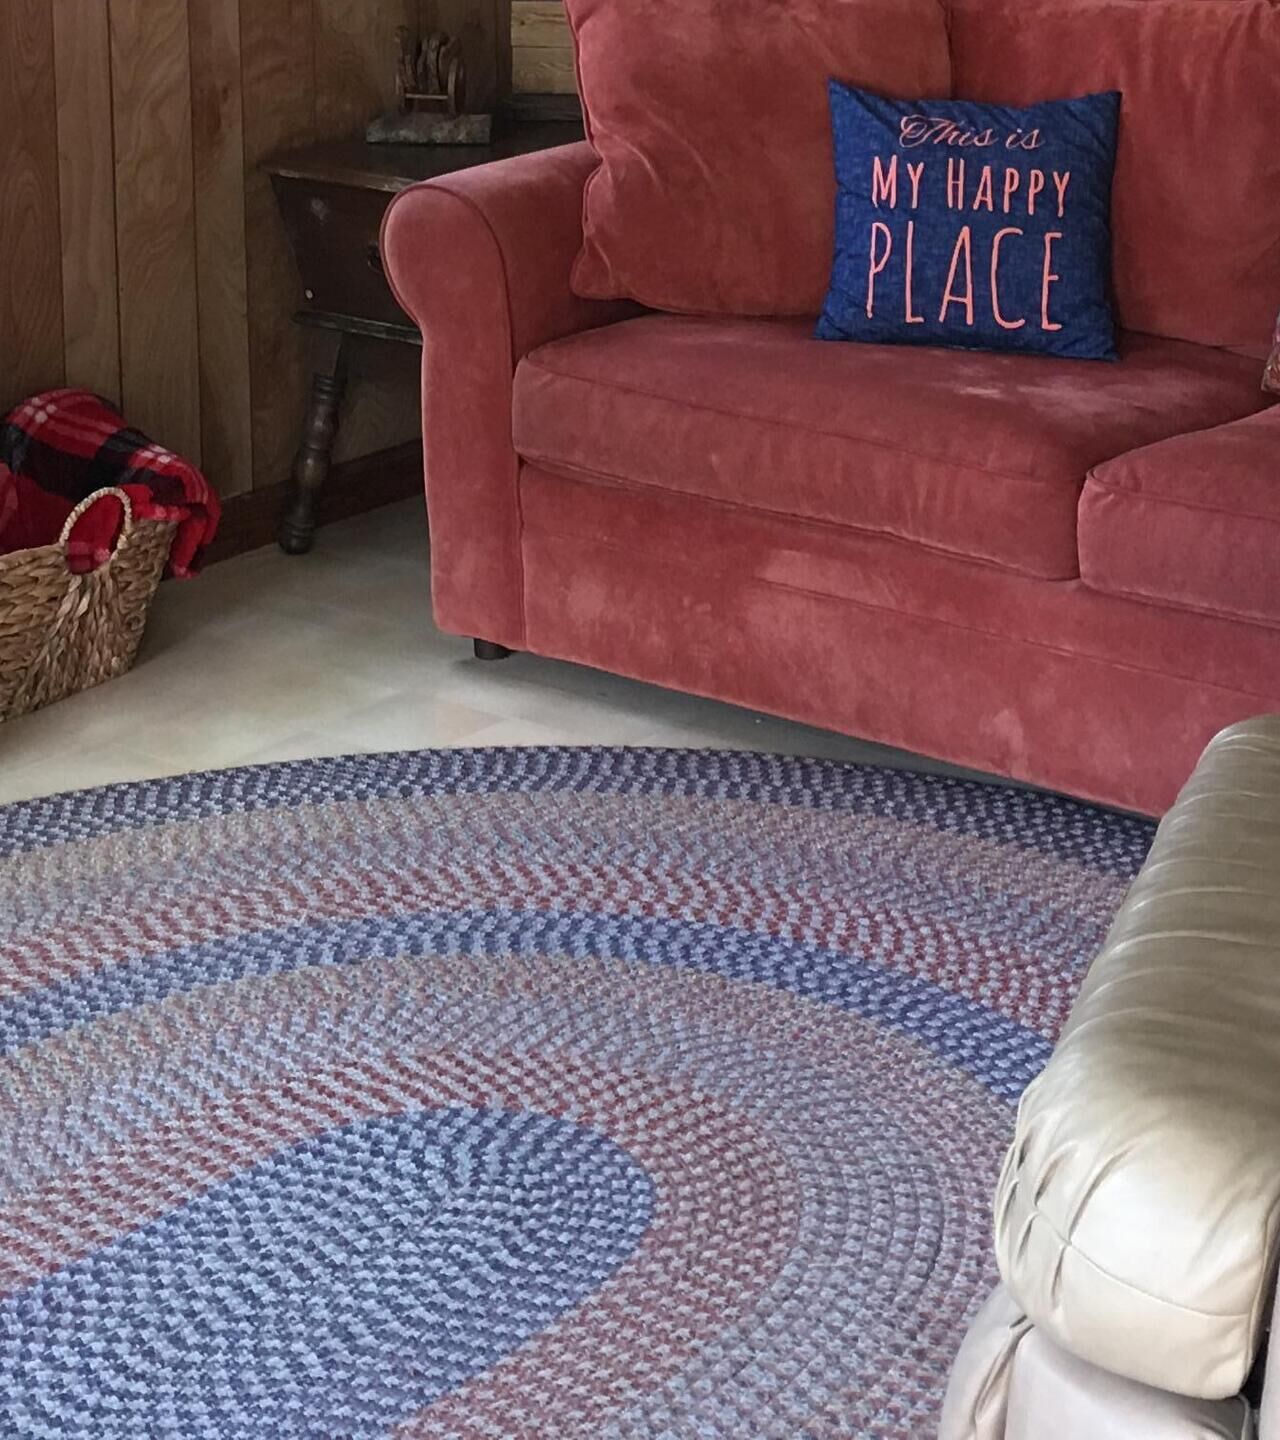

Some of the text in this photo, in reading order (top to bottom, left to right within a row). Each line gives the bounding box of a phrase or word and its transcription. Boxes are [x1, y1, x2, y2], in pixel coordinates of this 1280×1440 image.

[899, 114, 1046, 150] This is
[871, 154, 1071, 218] MY HAPPY
[866, 220, 1063, 331] PLACE
